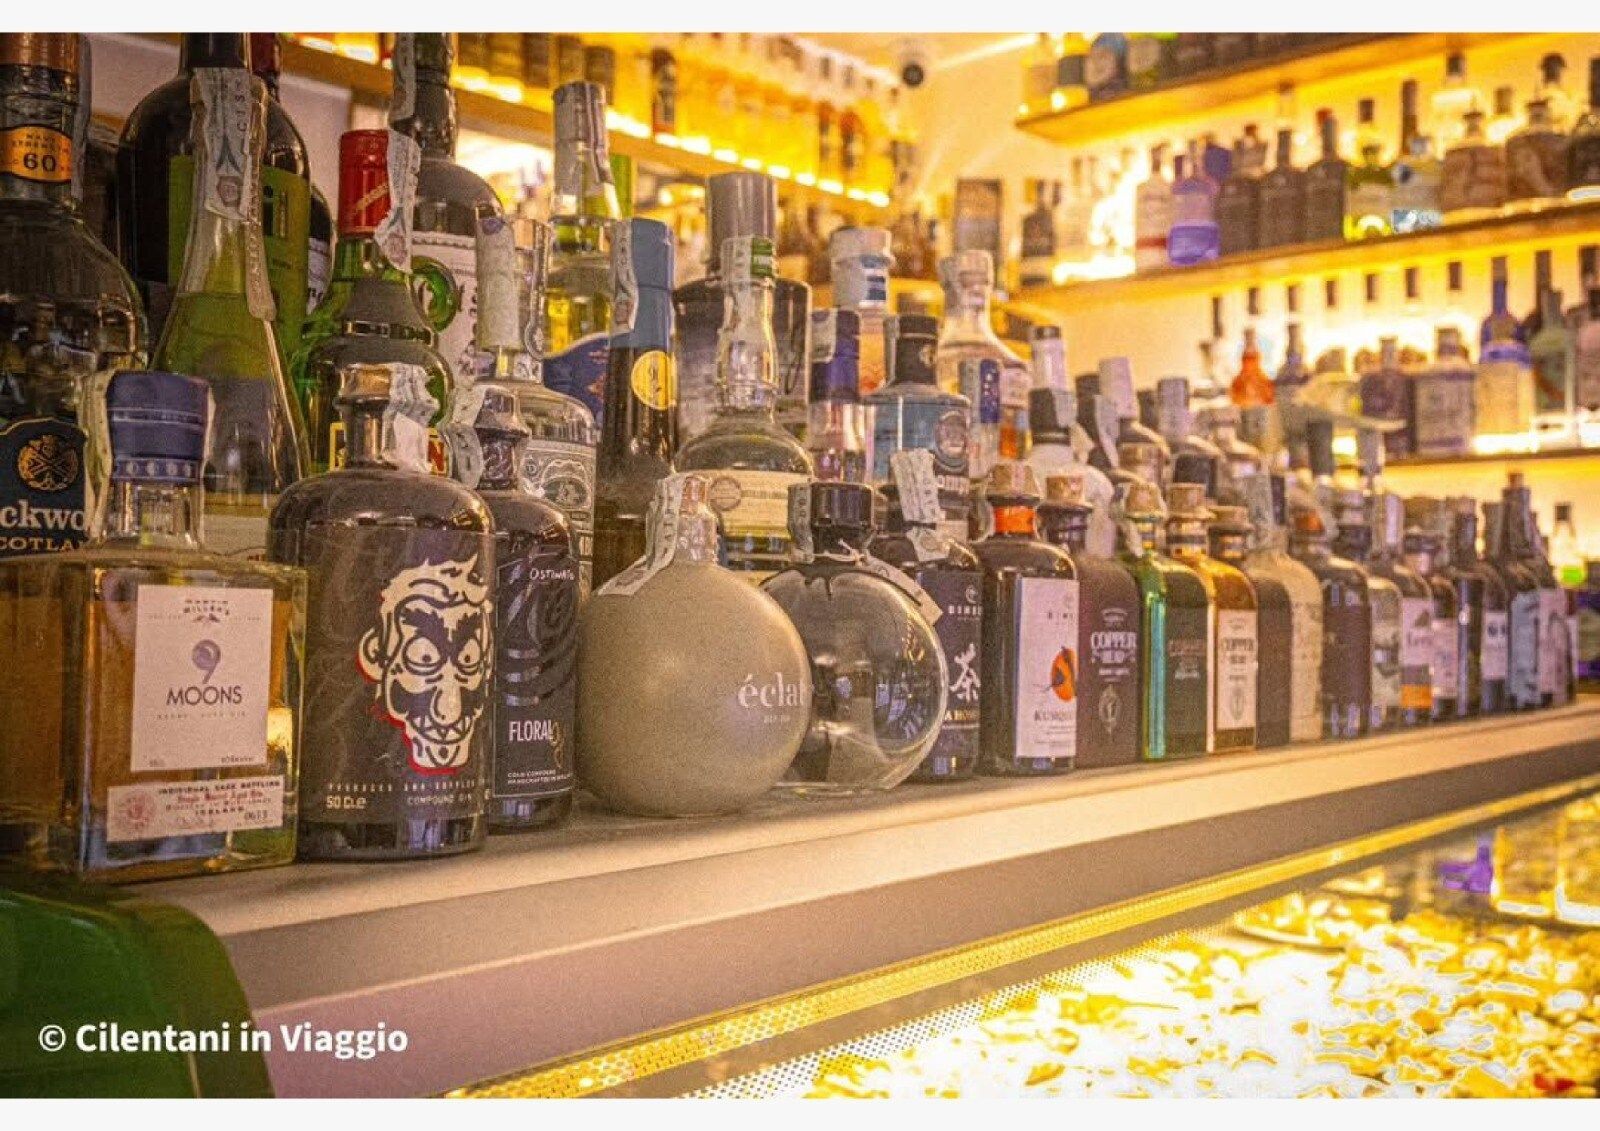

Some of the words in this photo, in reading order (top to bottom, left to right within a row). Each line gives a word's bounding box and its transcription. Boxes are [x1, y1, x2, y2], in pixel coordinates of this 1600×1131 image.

[23, 153, 56, 172] 60
[191, 639, 222, 684] 9
[166, 685, 243, 706] MOONS
[508, 719, 552, 742] FLORAL
[325, 794, 341, 810] 50
